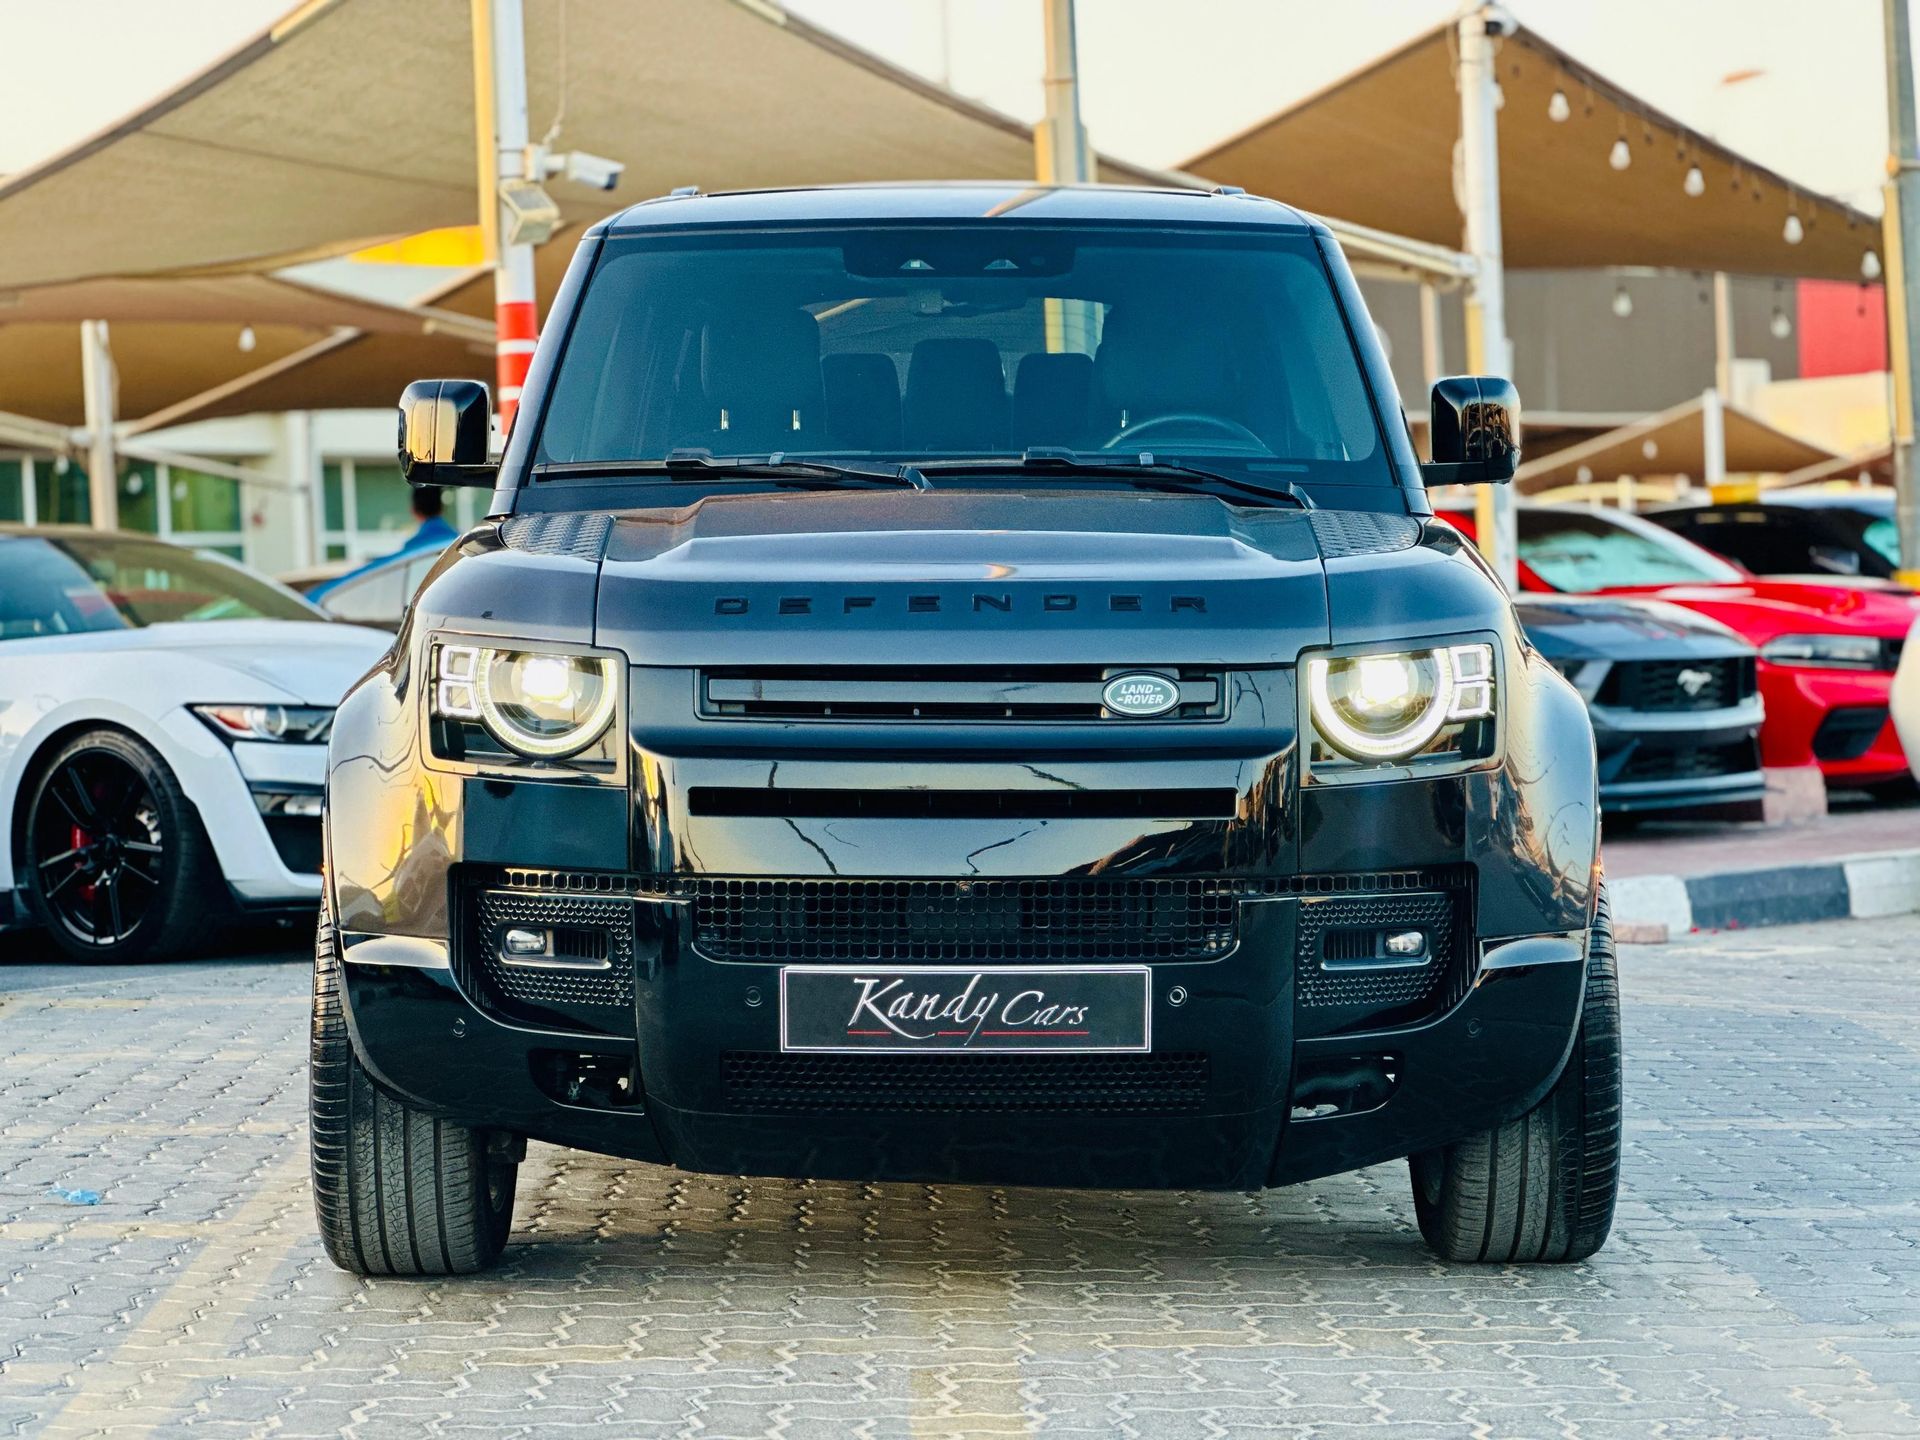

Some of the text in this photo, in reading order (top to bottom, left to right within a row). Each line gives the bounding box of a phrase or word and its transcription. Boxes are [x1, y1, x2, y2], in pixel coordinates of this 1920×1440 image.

[714, 594, 1207, 615] DEFENDER
[847, 973, 1089, 1047] Kandy Cars
